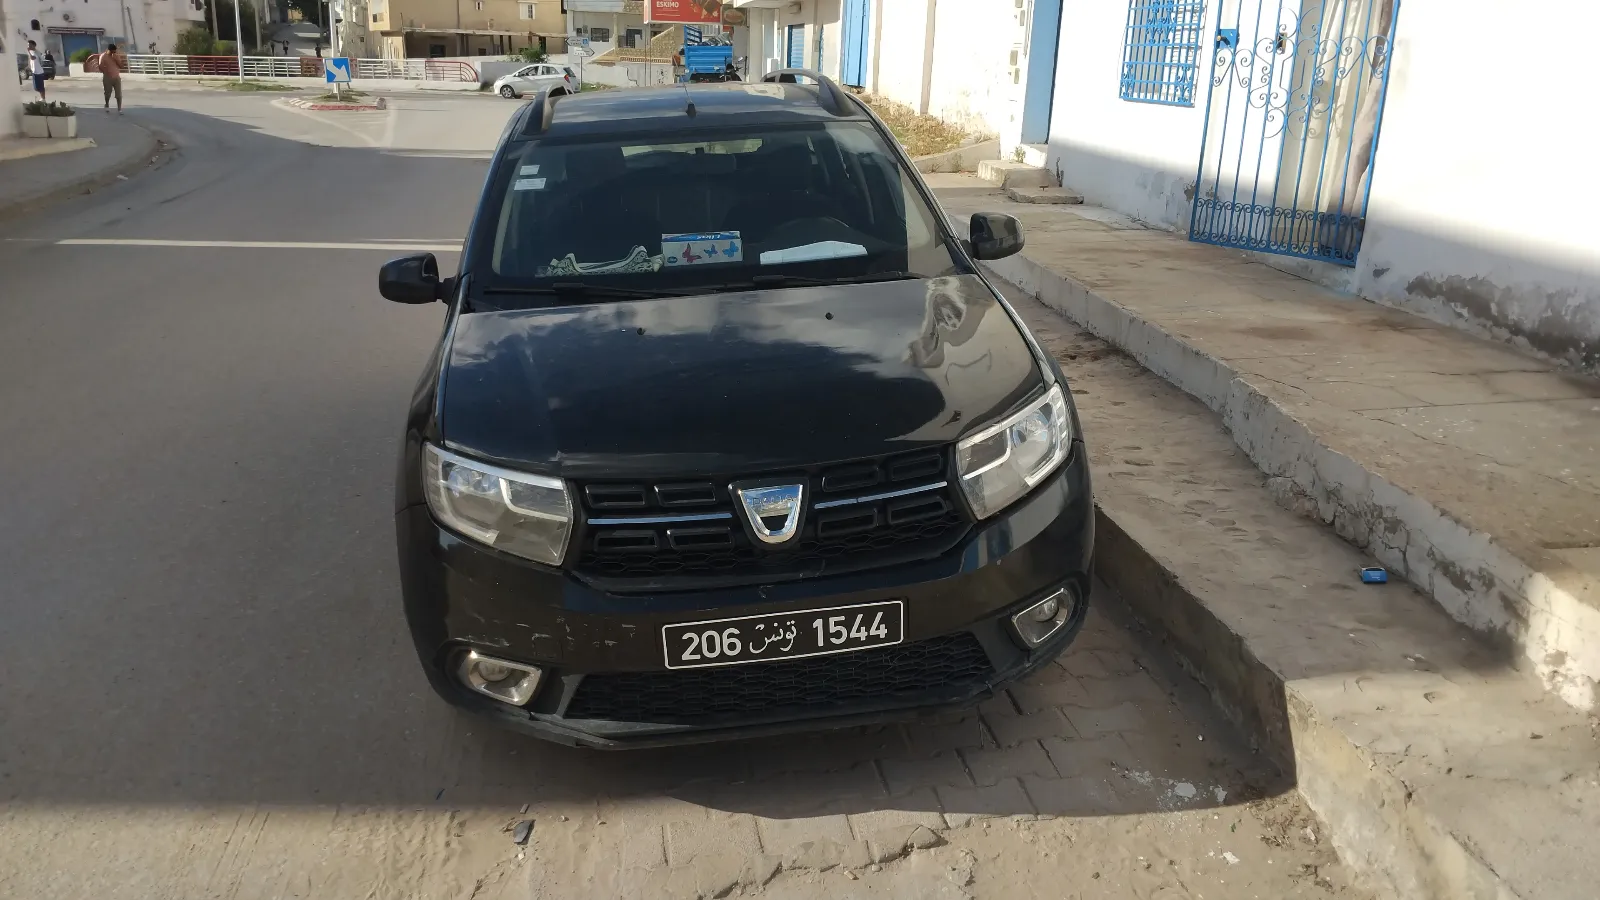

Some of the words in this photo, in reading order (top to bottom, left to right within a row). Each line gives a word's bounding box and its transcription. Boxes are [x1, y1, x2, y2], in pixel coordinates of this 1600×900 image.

[681, 627, 742, 661] 206
[749, 620, 797, 654] تونس
[812, 611, 888, 647] 1544
